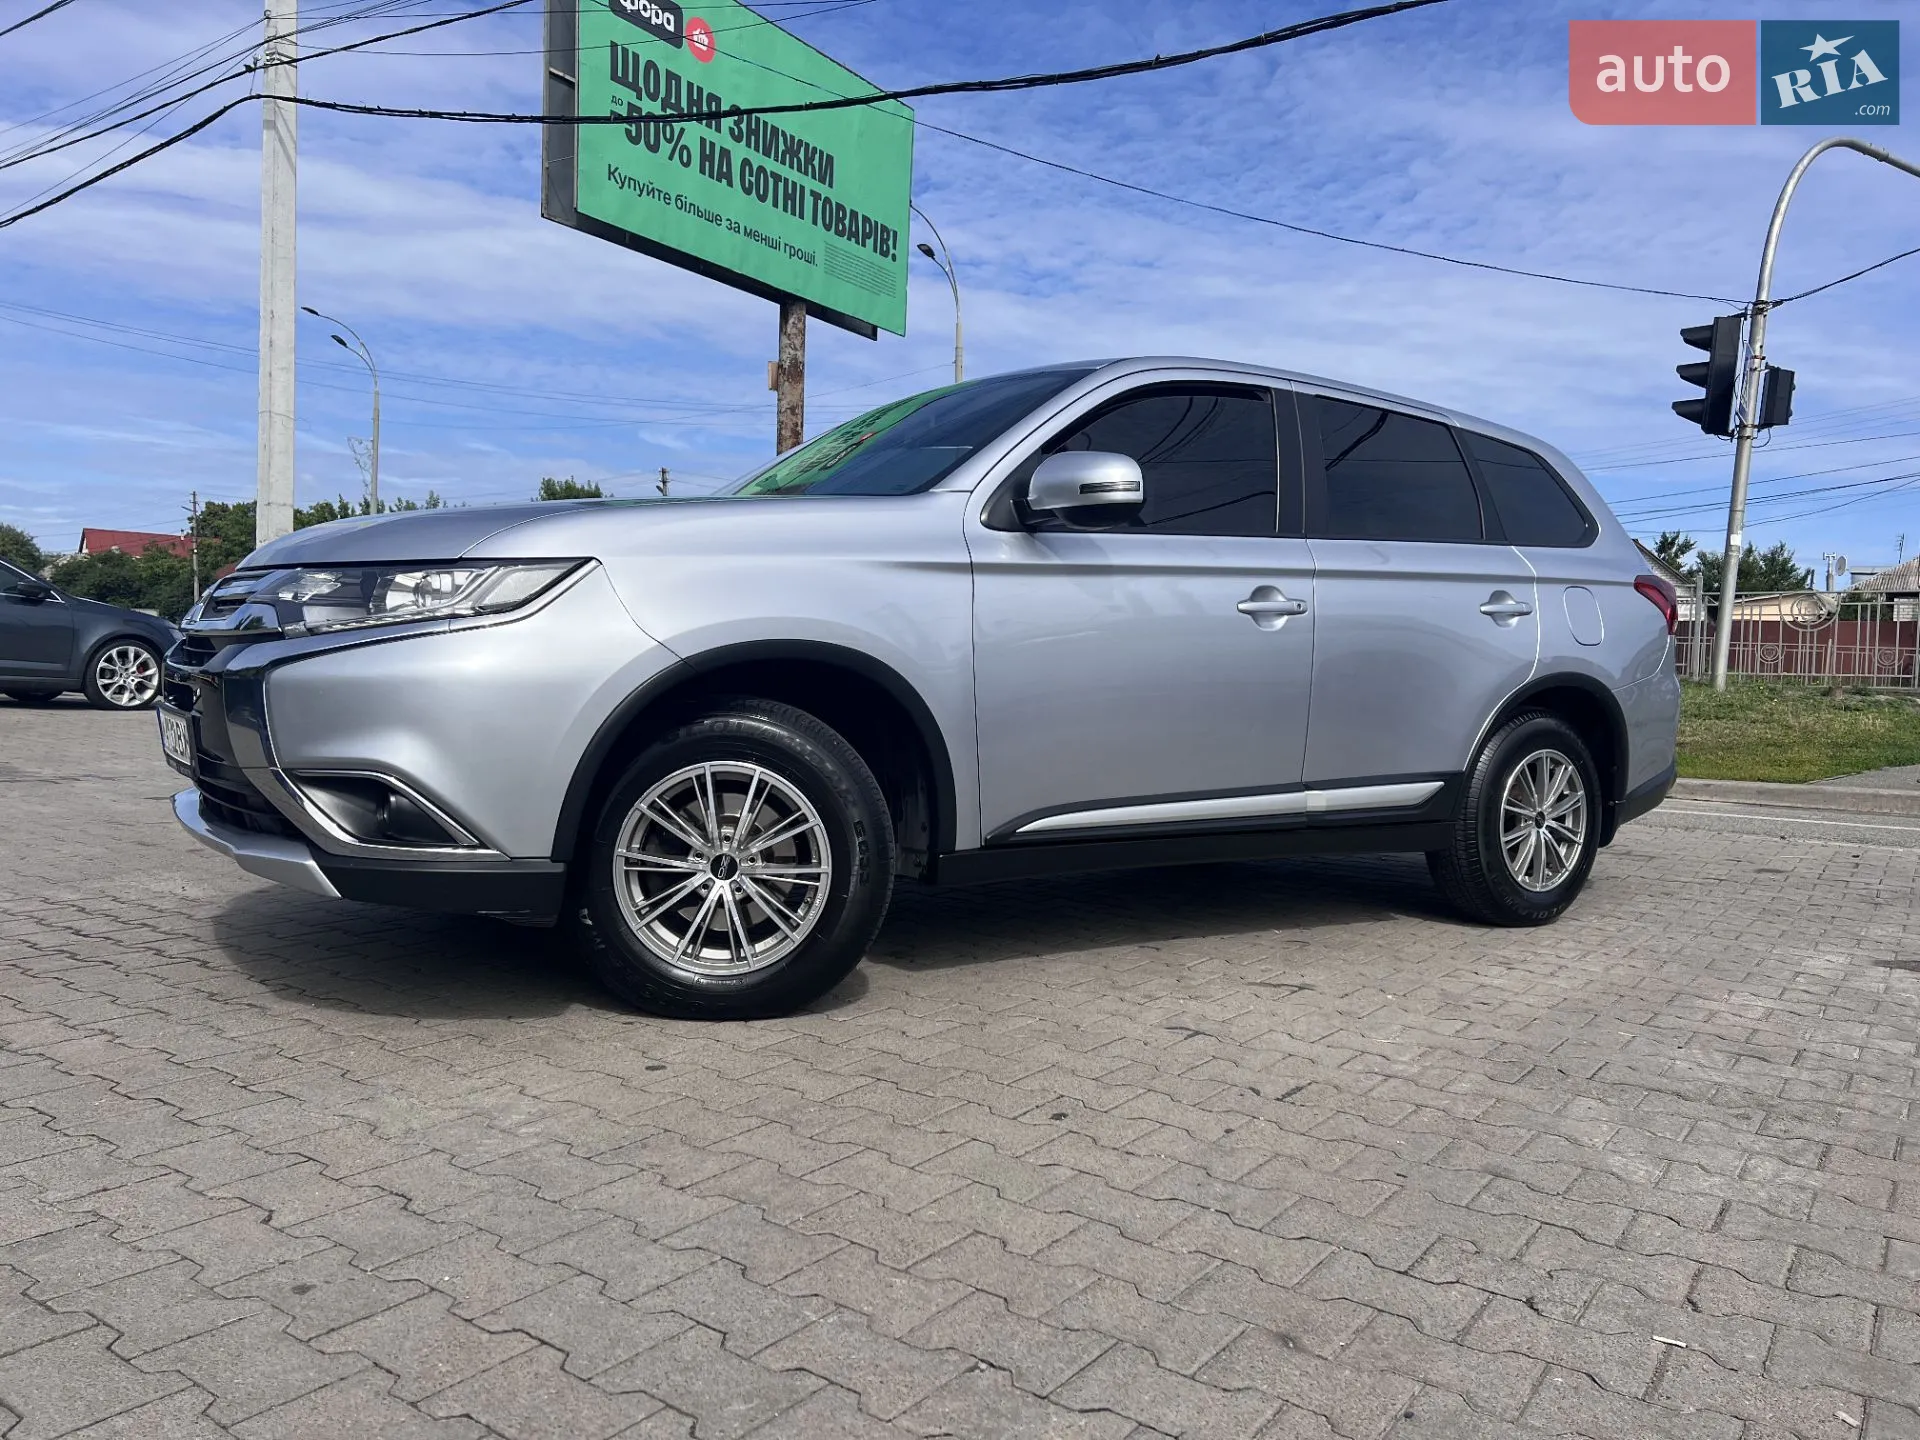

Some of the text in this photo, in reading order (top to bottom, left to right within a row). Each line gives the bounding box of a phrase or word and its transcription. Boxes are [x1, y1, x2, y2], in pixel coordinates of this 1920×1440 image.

[610, 40, 835, 189] ЩОДНЯ ЗНИЖКИ
[611, 95, 624, 107] до
[607, 163, 819, 267] Купуйте більше за менші гроші.
[699, 136, 734, 188] НА
[739, 157, 806, 220] СОТНІ
[810, 189, 898, 262] ТОВАРІВ!
